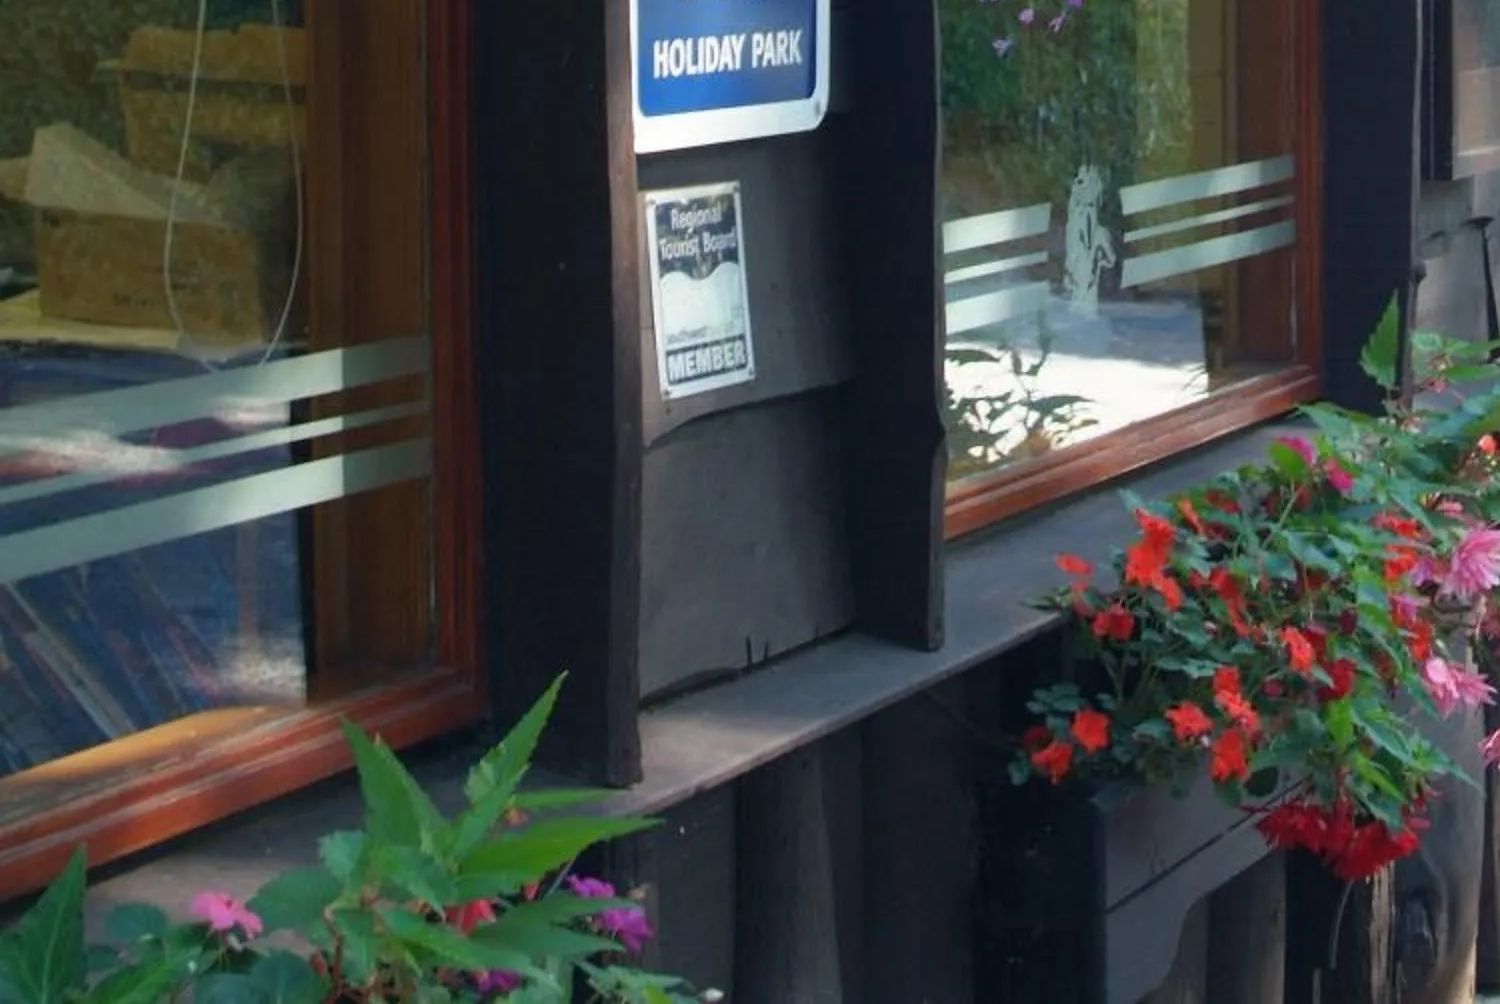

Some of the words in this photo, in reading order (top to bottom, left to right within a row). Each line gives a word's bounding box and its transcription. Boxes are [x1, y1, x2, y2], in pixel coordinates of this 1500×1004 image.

[653, 33, 746, 79] HOLIDAY
[752, 29, 802, 68] PARK
[671, 203, 722, 232] Regional
[659, 236, 700, 261] Tourist
[702, 226, 737, 253] Board
[667, 340, 746, 382] MEMBER
